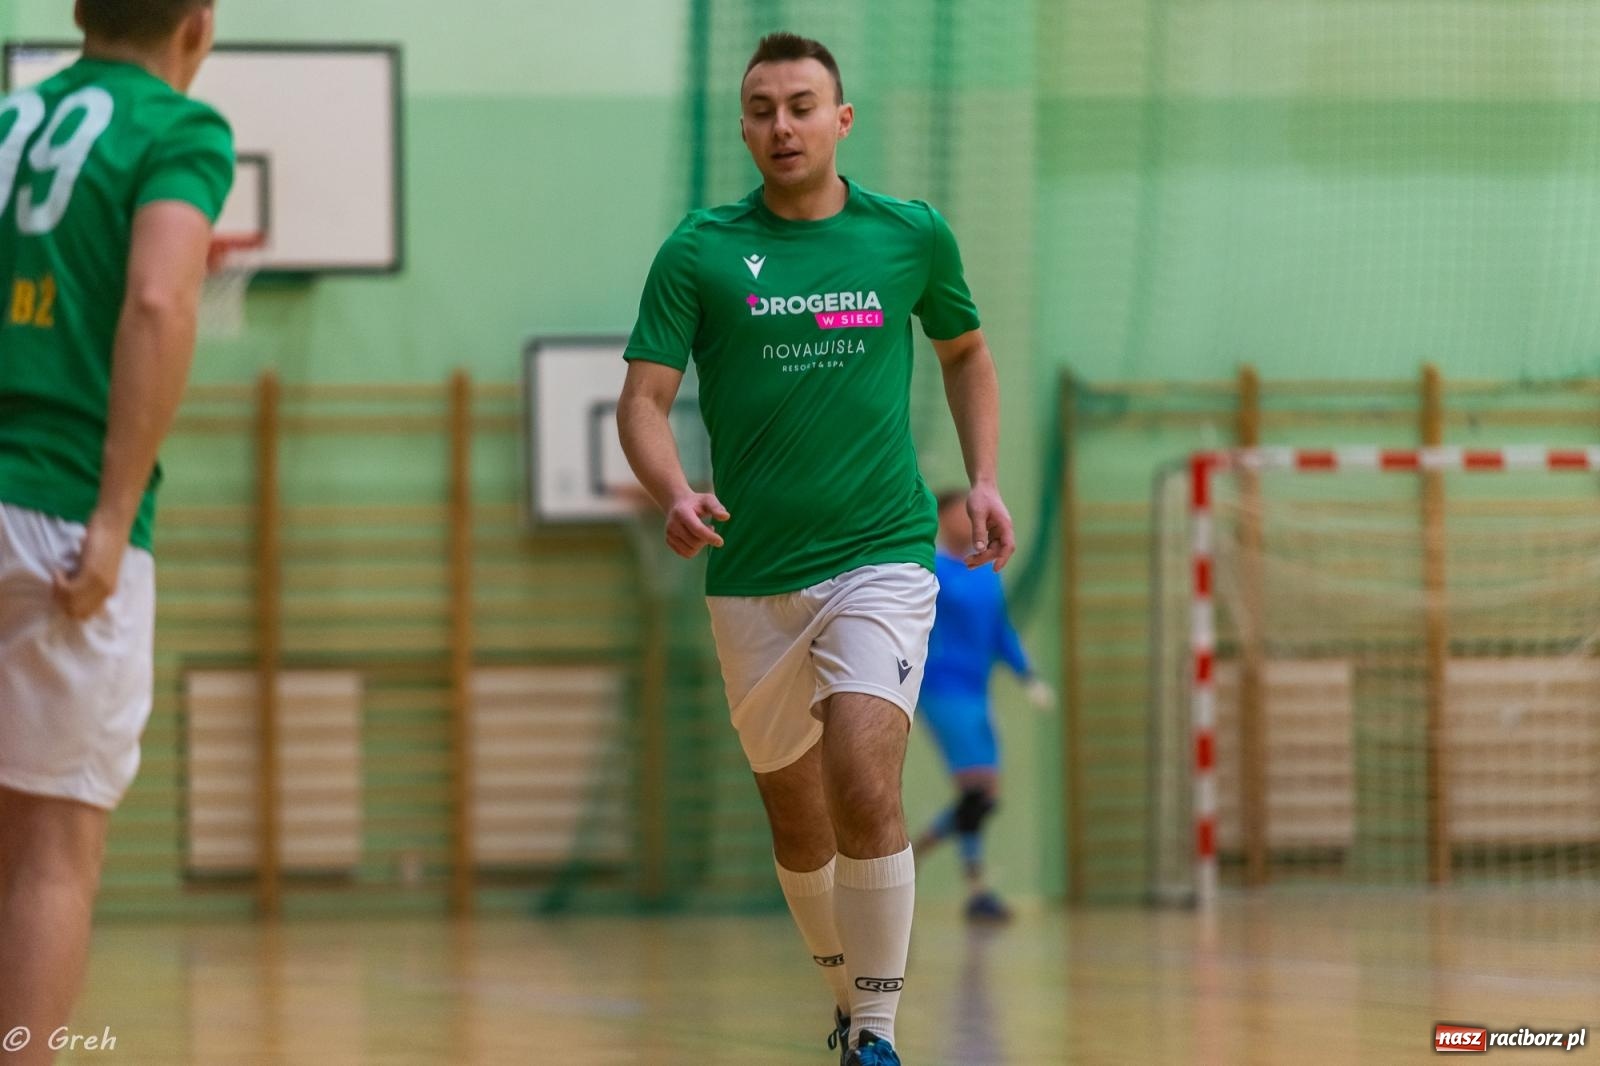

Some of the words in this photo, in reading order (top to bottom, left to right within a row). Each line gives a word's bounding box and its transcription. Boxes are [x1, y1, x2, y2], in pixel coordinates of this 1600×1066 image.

[750, 291, 882, 316] DROGERIA
[822, 316, 835, 326] W
[841, 314, 879, 325] SIECI
